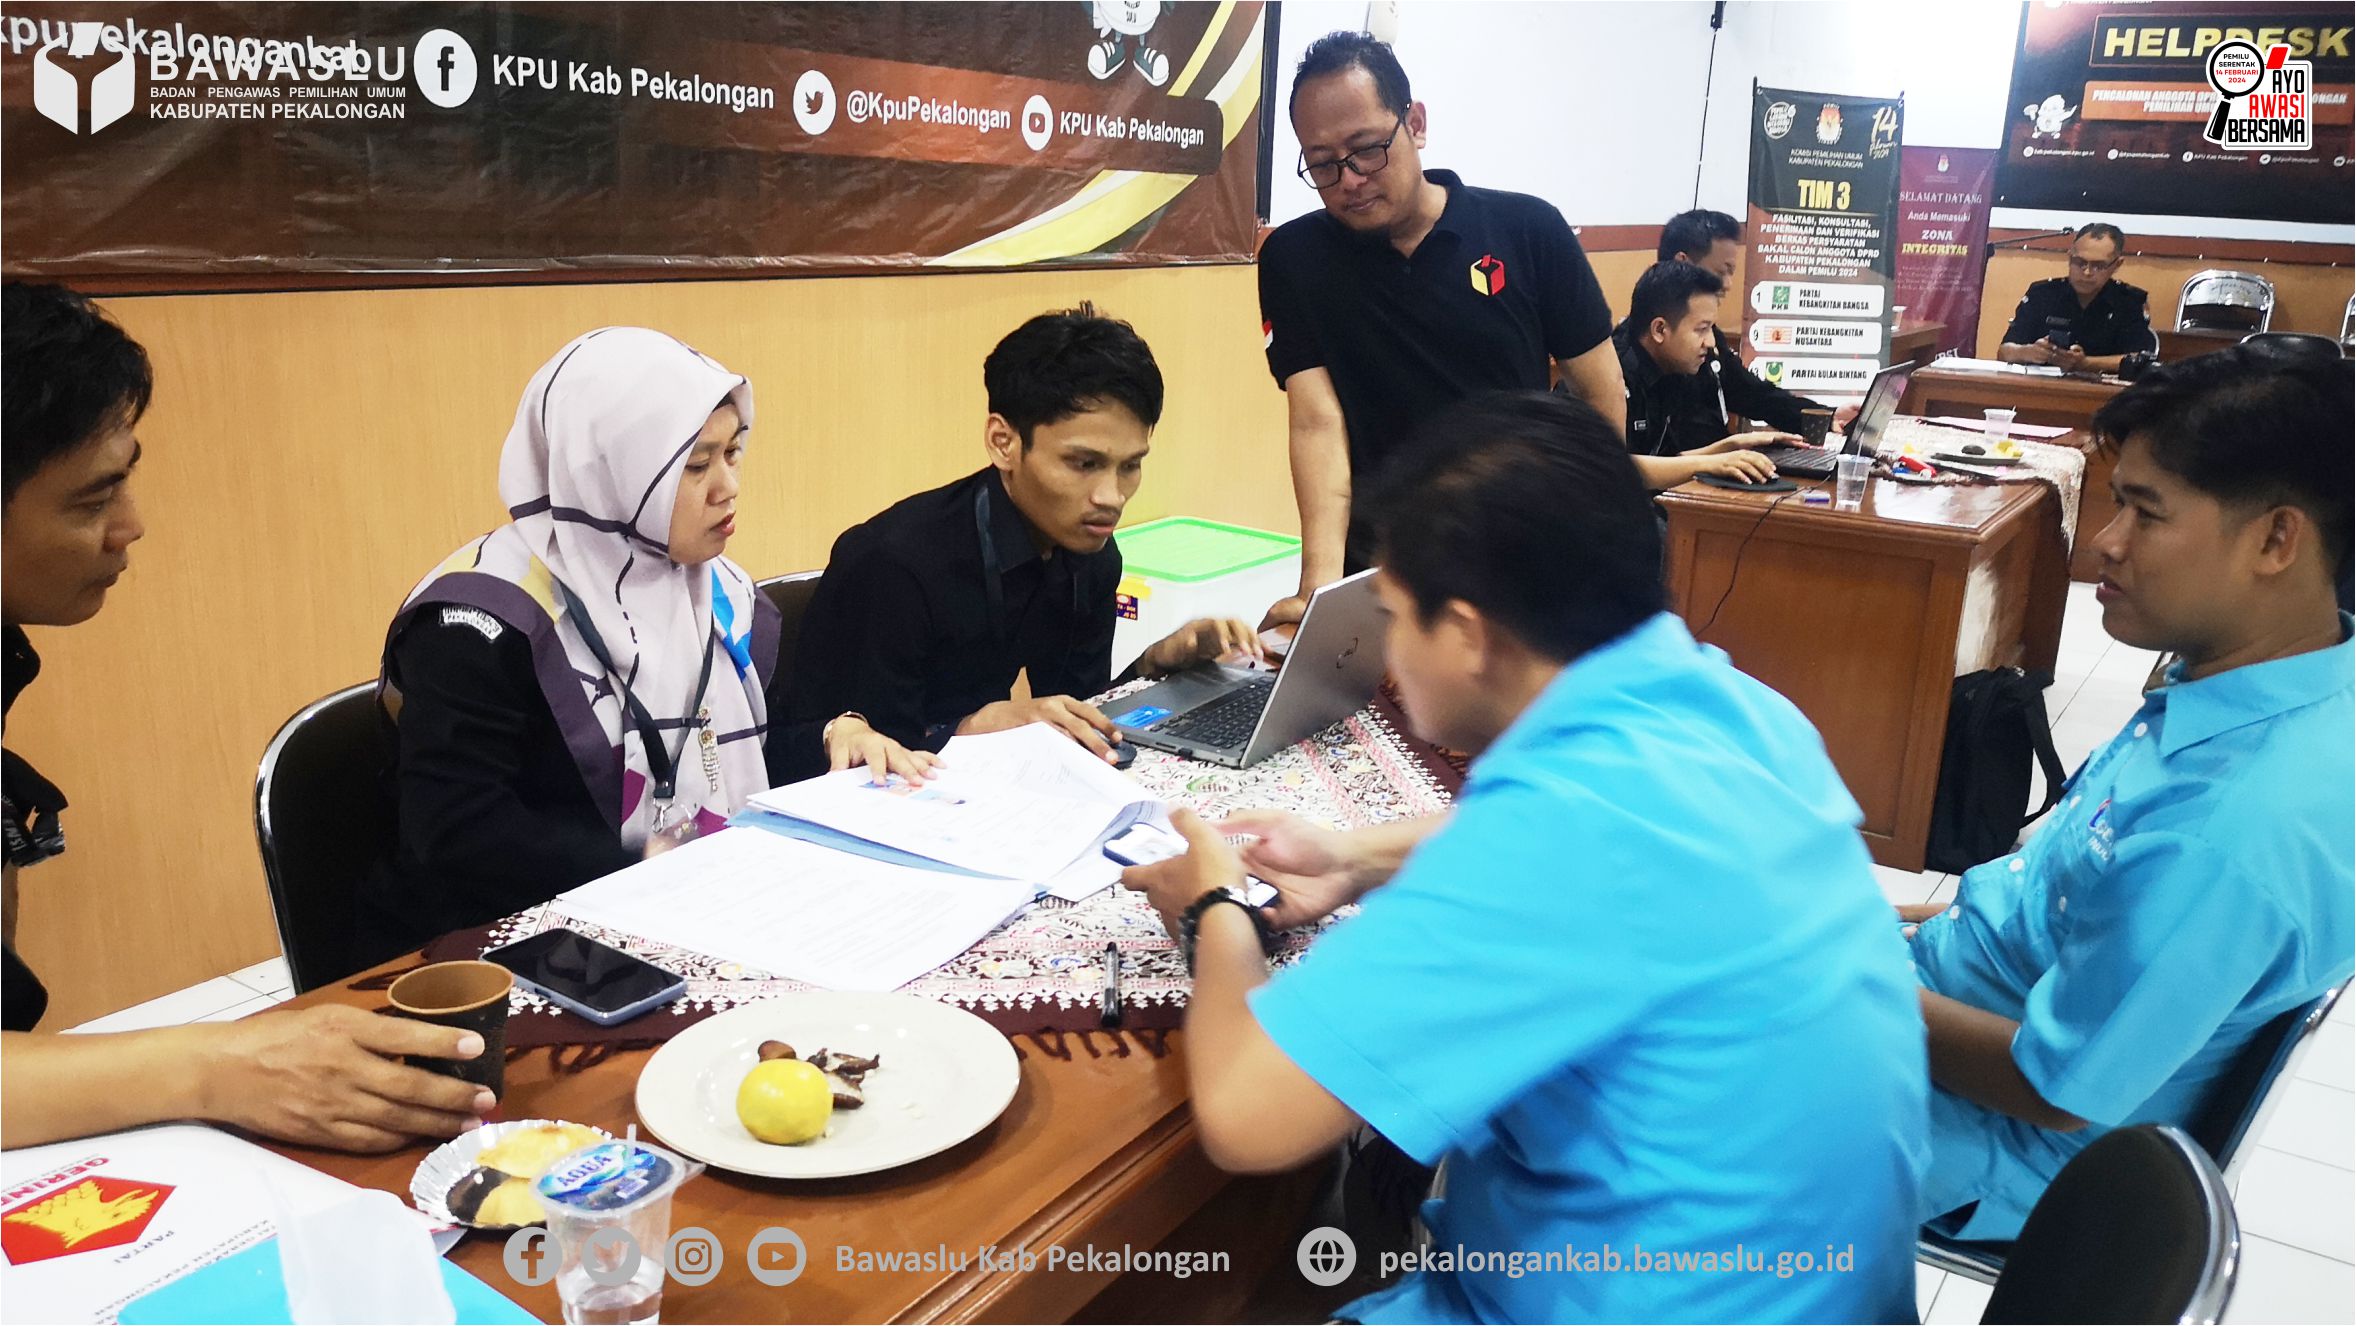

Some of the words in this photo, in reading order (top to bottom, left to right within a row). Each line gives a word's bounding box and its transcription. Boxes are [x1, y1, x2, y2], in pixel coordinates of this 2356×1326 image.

[493, 54, 558, 89] KPU
[568, 61, 622, 96] Kab
[631, 68, 774, 113] Pekalongan
[846, 90, 1011, 134] @KpuPekalongan
[1060, 111, 1091, 136] KPU
[1096, 114, 1126, 139] Kab
[1129, 117, 1204, 149] Pekalongan
[1797, 178, 1834, 209] TIM
[1836, 181, 1851, 210] 3
[1899, 191, 1943, 204] SELAMAT
[1945, 192, 1982, 205] DATANG
[1907, 210, 1928, 221] Anda
[1930, 211, 1971, 223] Memasuki
[1834, 227, 1880, 238] VERIFIKASI
[1921, 229, 1953, 241] ZONA
[1775, 234, 1808, 245] BERKAS
[1808, 236, 1866, 248] PERSYARATAN
[1758, 244, 1788, 254] BAKAL
[1790, 246, 1816, 255] CALON
[1817, 247, 1856, 257] ANGGOTA
[1857, 249, 1880, 258] DPRD
[1901, 243, 1968, 256] INTEGRITAS
[1764, 254, 1815, 265] KABUPATEN
[1816, 256, 1871, 267] PEKALONGAN
[1778, 264, 1807, 275] DALAM
[1807, 266, 1838, 276] PEMILU
[1838, 268, 1858, 277] 2024
[1799, 288, 1821, 298] PARTAI
[1799, 299, 1841, 309] KEBANGKITAN
[1842, 301, 1870, 310] BANGSA
[1796, 326, 1819, 336] PARTAI
[1819, 327, 1864, 337] KEBANGKITAN
[1795, 337, 1833, 346] NUSANTARA
[1791, 369, 1817, 378] PARTAI
[1838, 371, 1868, 379] BINTANG
[556, 1154, 613, 1187] AQUA
[1, 1157, 109, 1206] GERIN
[114, 1230, 175, 1264] PARTAI
